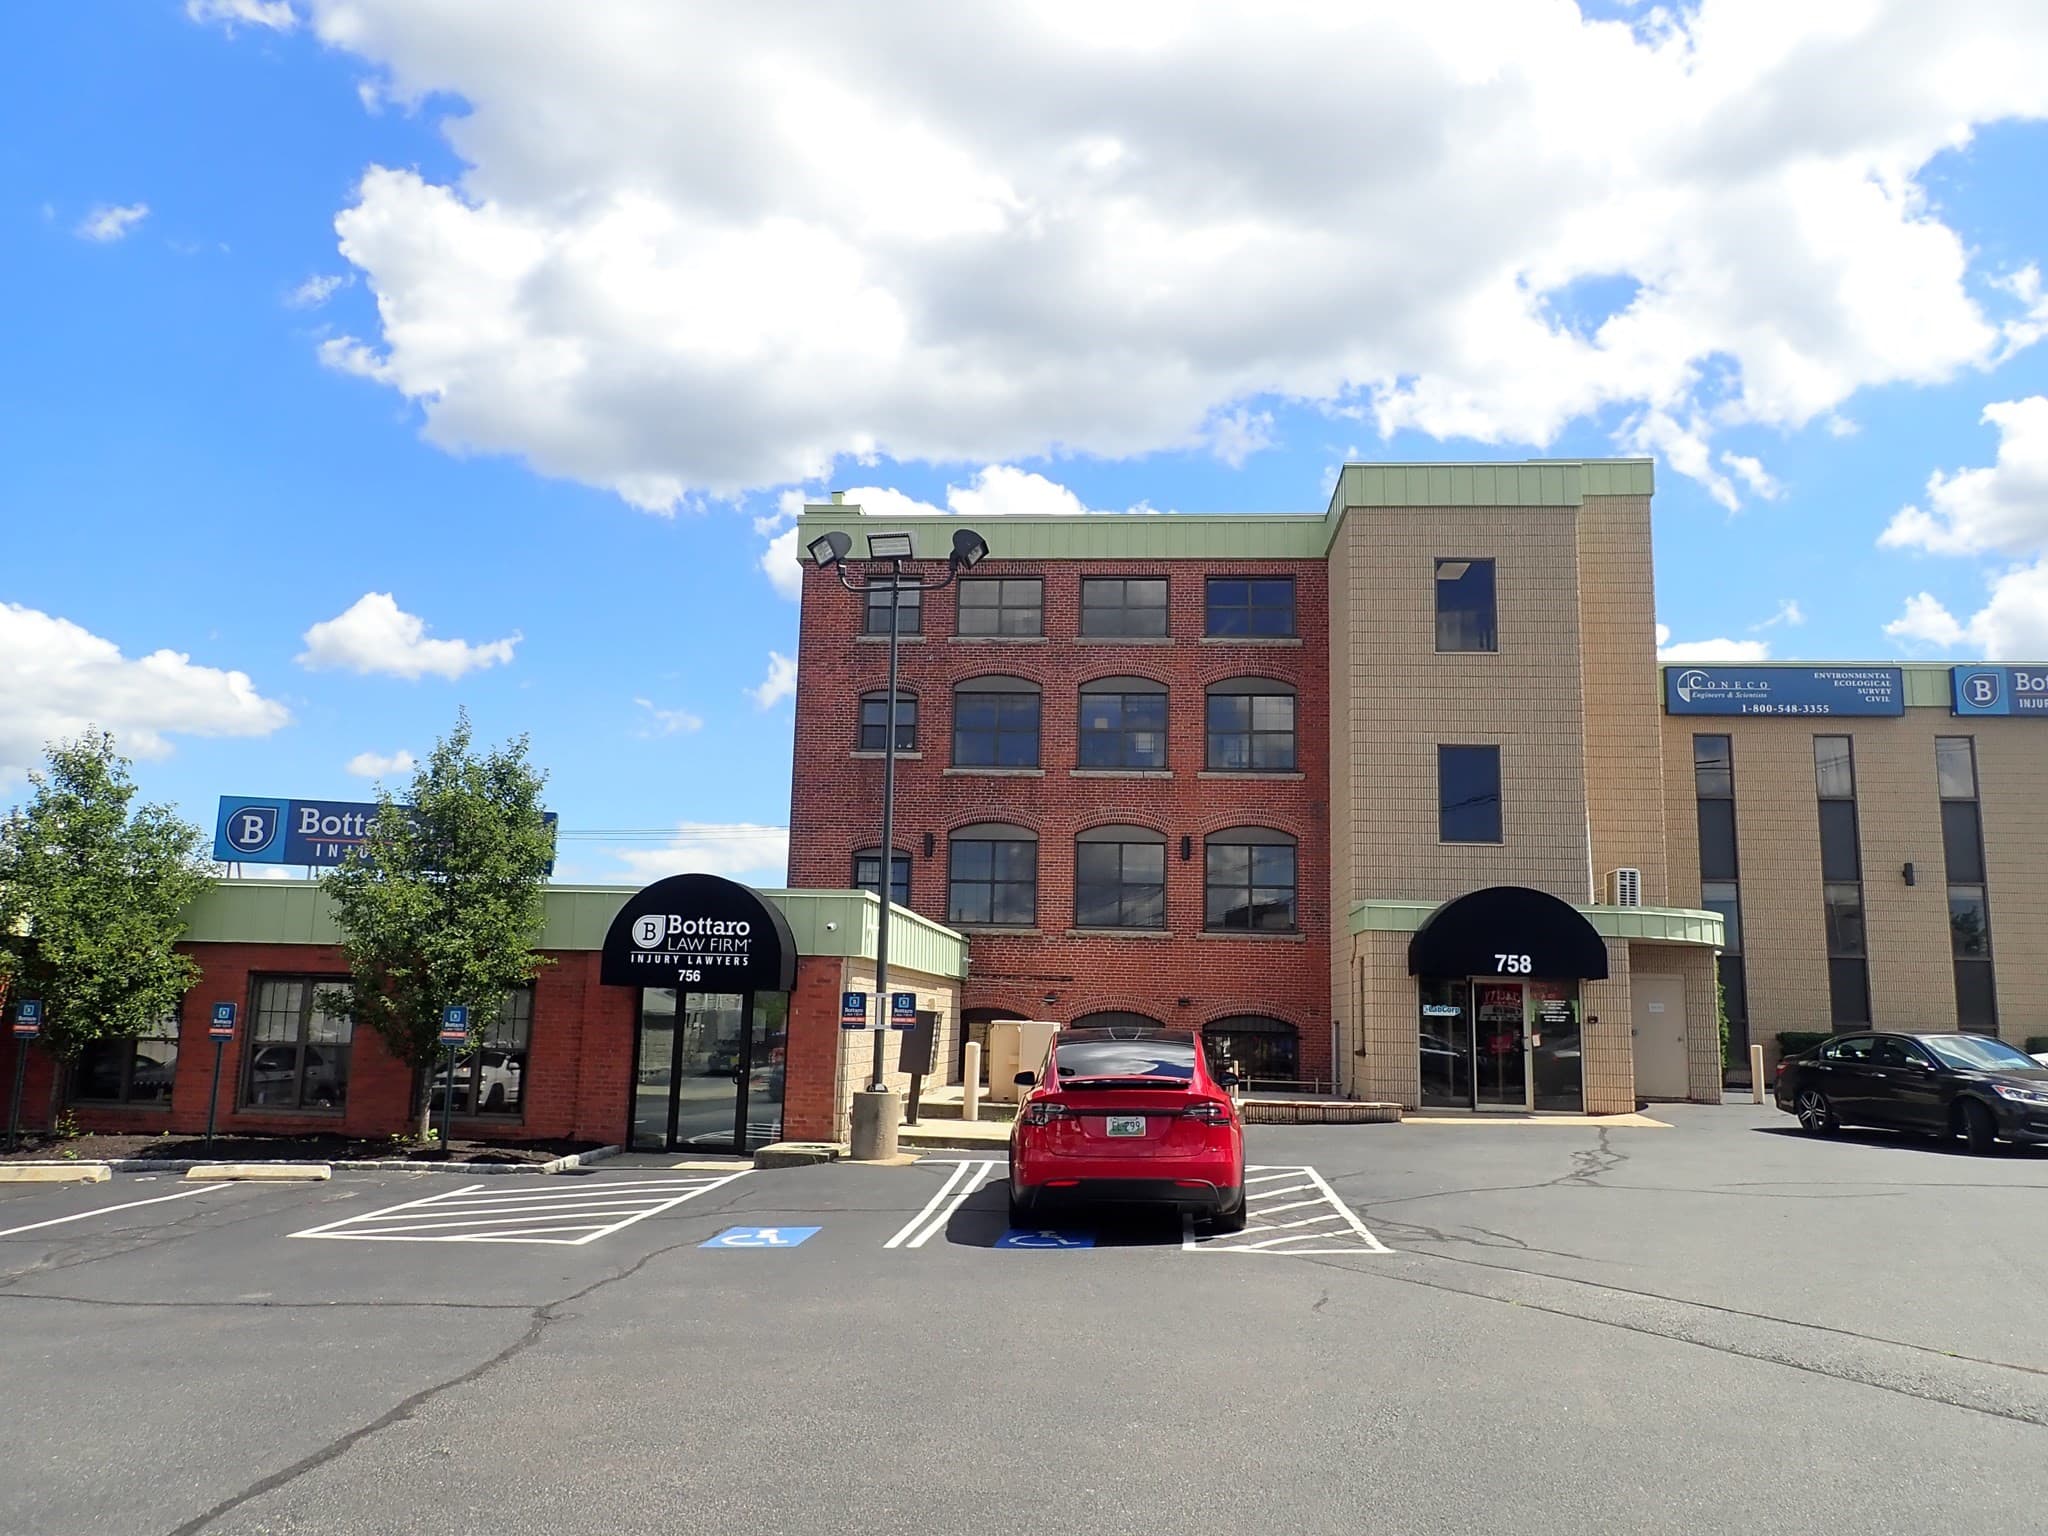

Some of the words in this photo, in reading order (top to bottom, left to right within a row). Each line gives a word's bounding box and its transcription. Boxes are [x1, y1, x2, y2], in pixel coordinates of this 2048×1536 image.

[1689, 675, 1769, 689] CONECO
[1814, 672, 1891, 680] ENVIRONMENTAL
[1692, 691, 1725, 699] Engineers
[1857, 687, 1891, 695] SURVEY
[1973, 680, 1992, 701] B
[1865, 695, 1891, 703] CIVIL
[1741, 704, 1830, 713] 1-800-548-3355
[239, 815, 264, 843] B
[642, 922, 656, 940] B
[667, 914, 750, 936] Bottaro
[667, 937, 706, 951] LAW
[710, 938, 748, 952] FIRM
[631, 954, 679, 964] INJURY
[687, 955, 749, 966] LAWYERS
[1494, 954, 1532, 973] 758
[678, 969, 701, 982] 756
[1428, 1005, 1460, 1013] LabCorp
